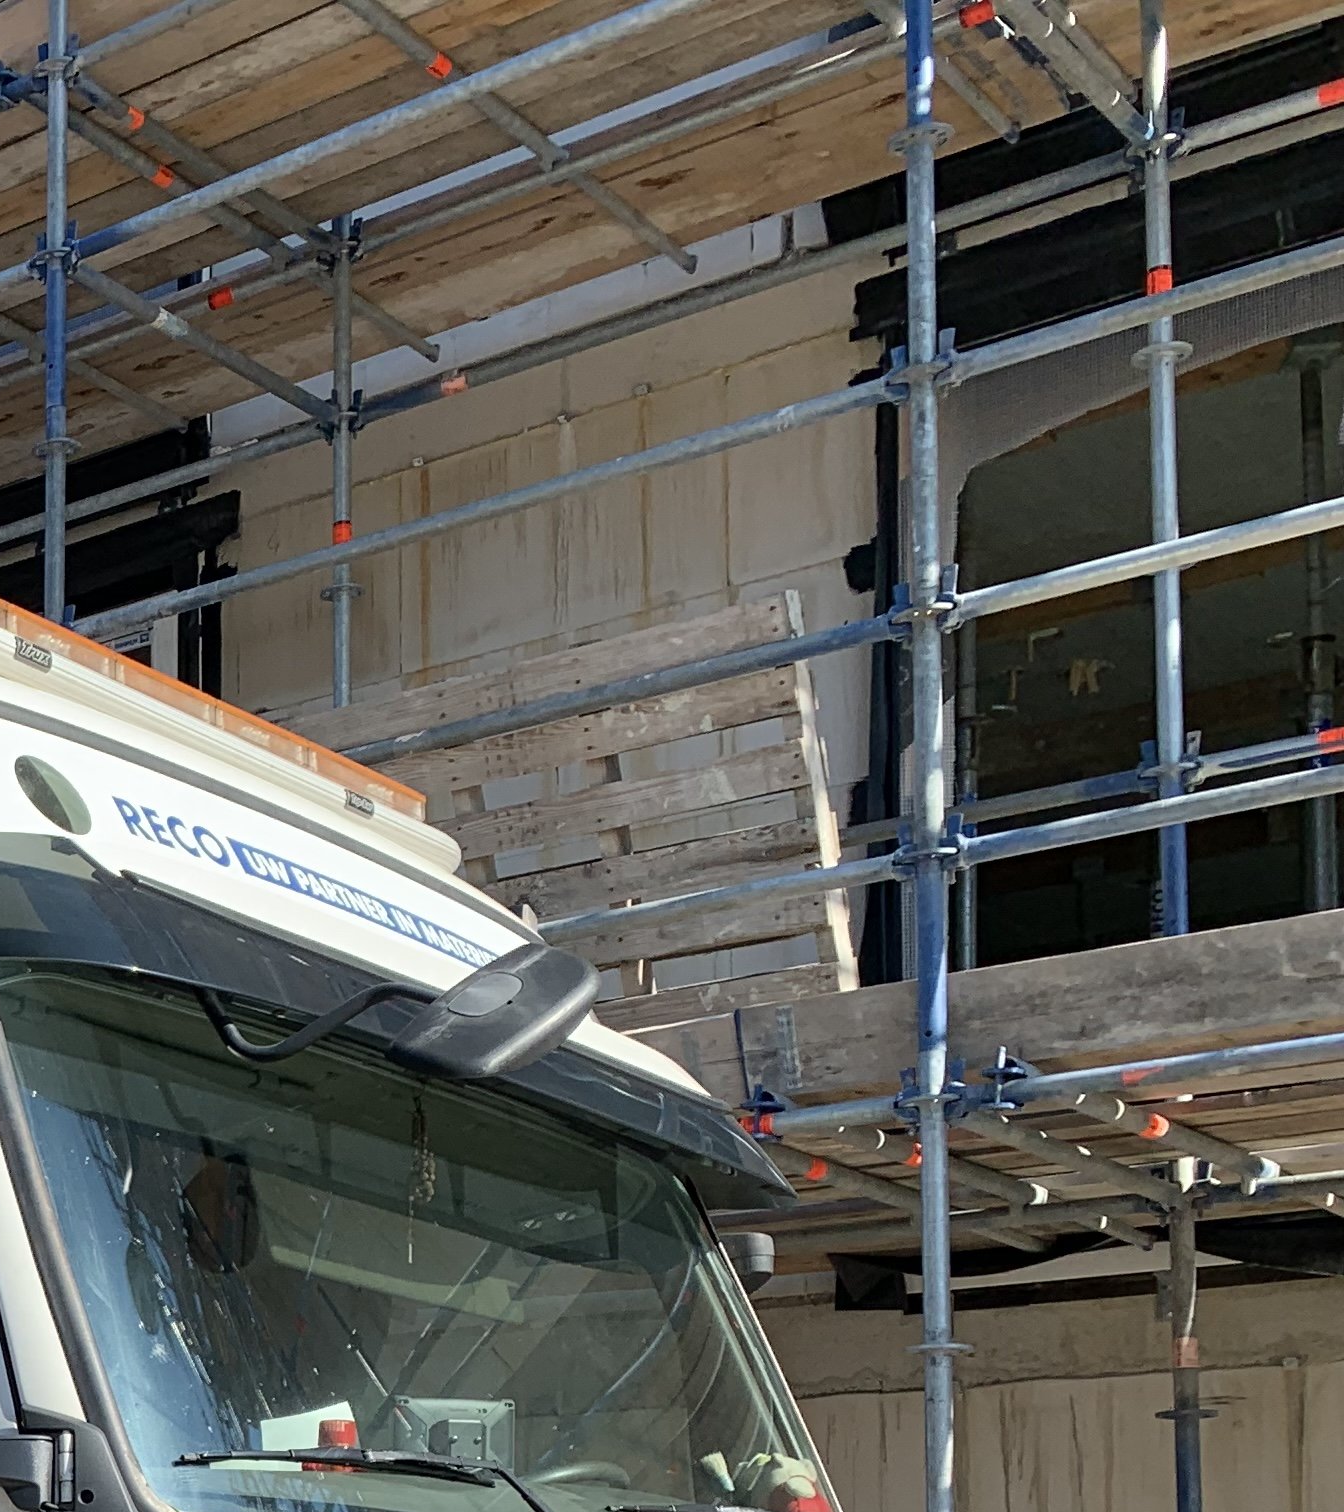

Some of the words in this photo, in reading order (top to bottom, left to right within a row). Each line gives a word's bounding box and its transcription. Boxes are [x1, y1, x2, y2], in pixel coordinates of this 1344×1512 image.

[112, 796, 230, 867] RECO
[243, 848, 290, 885] UW
[290, 867, 395, 927] PARTNER
[389, 907, 422, 939] IN
